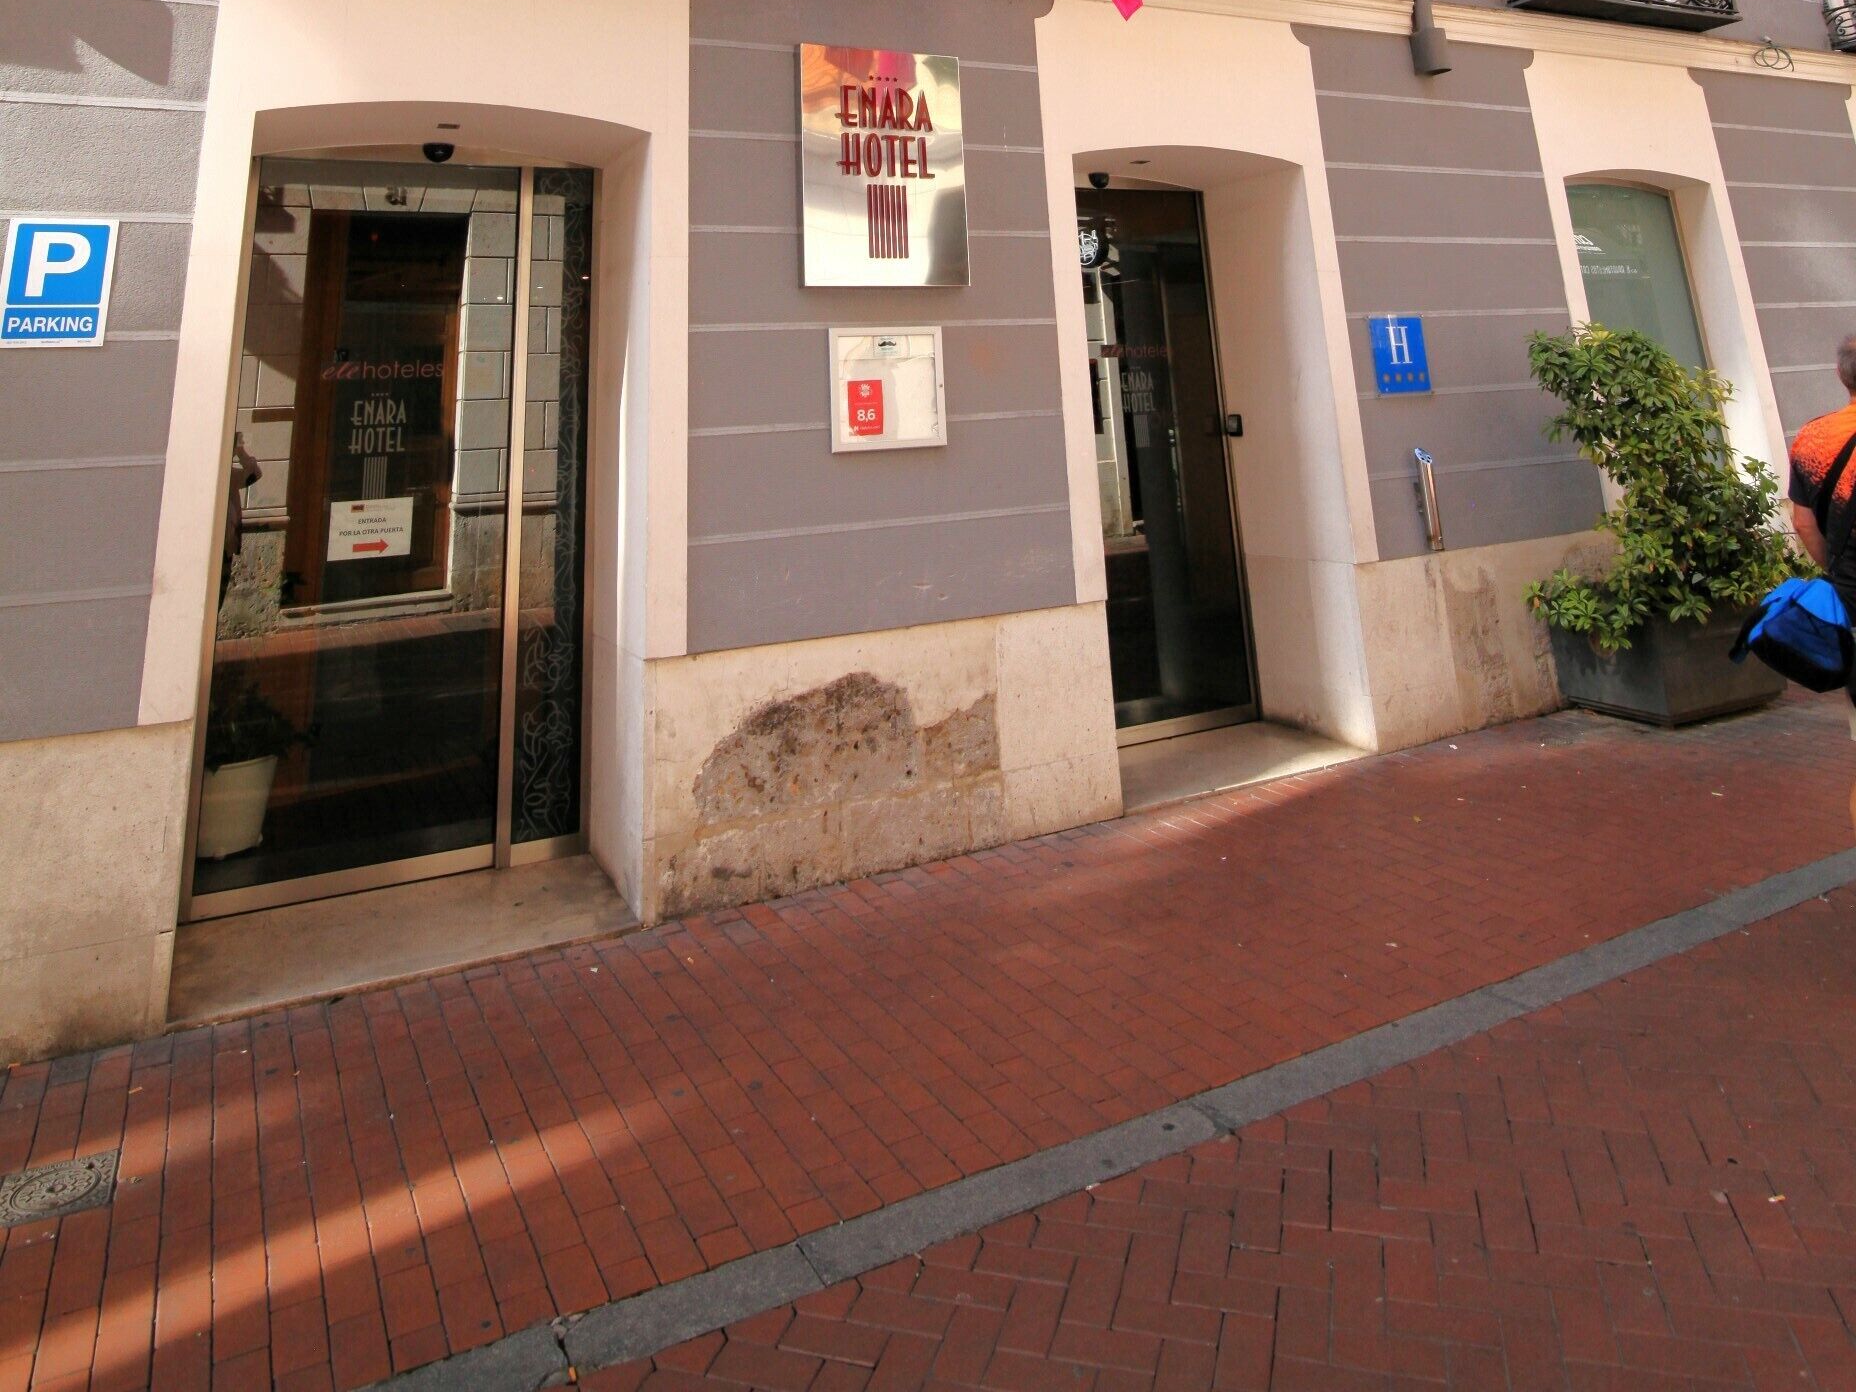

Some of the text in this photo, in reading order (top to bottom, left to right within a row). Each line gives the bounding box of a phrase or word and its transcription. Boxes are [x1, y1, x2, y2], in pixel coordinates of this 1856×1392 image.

[835, 84, 933, 133] ENARA
[836, 132, 935, 179] HOTEL
[24, 231, 91, 298] P
[7, 315, 93, 333] PARKING
[1385, 325, 1413, 365] H
[350, 398, 407, 426] ENARA
[856, 408, 876, 423] 8,6
[348, 427, 405, 455] HOTEL
[357, 517, 387, 525] ENTRADA
[380, 526, 404, 534] PUERTA
